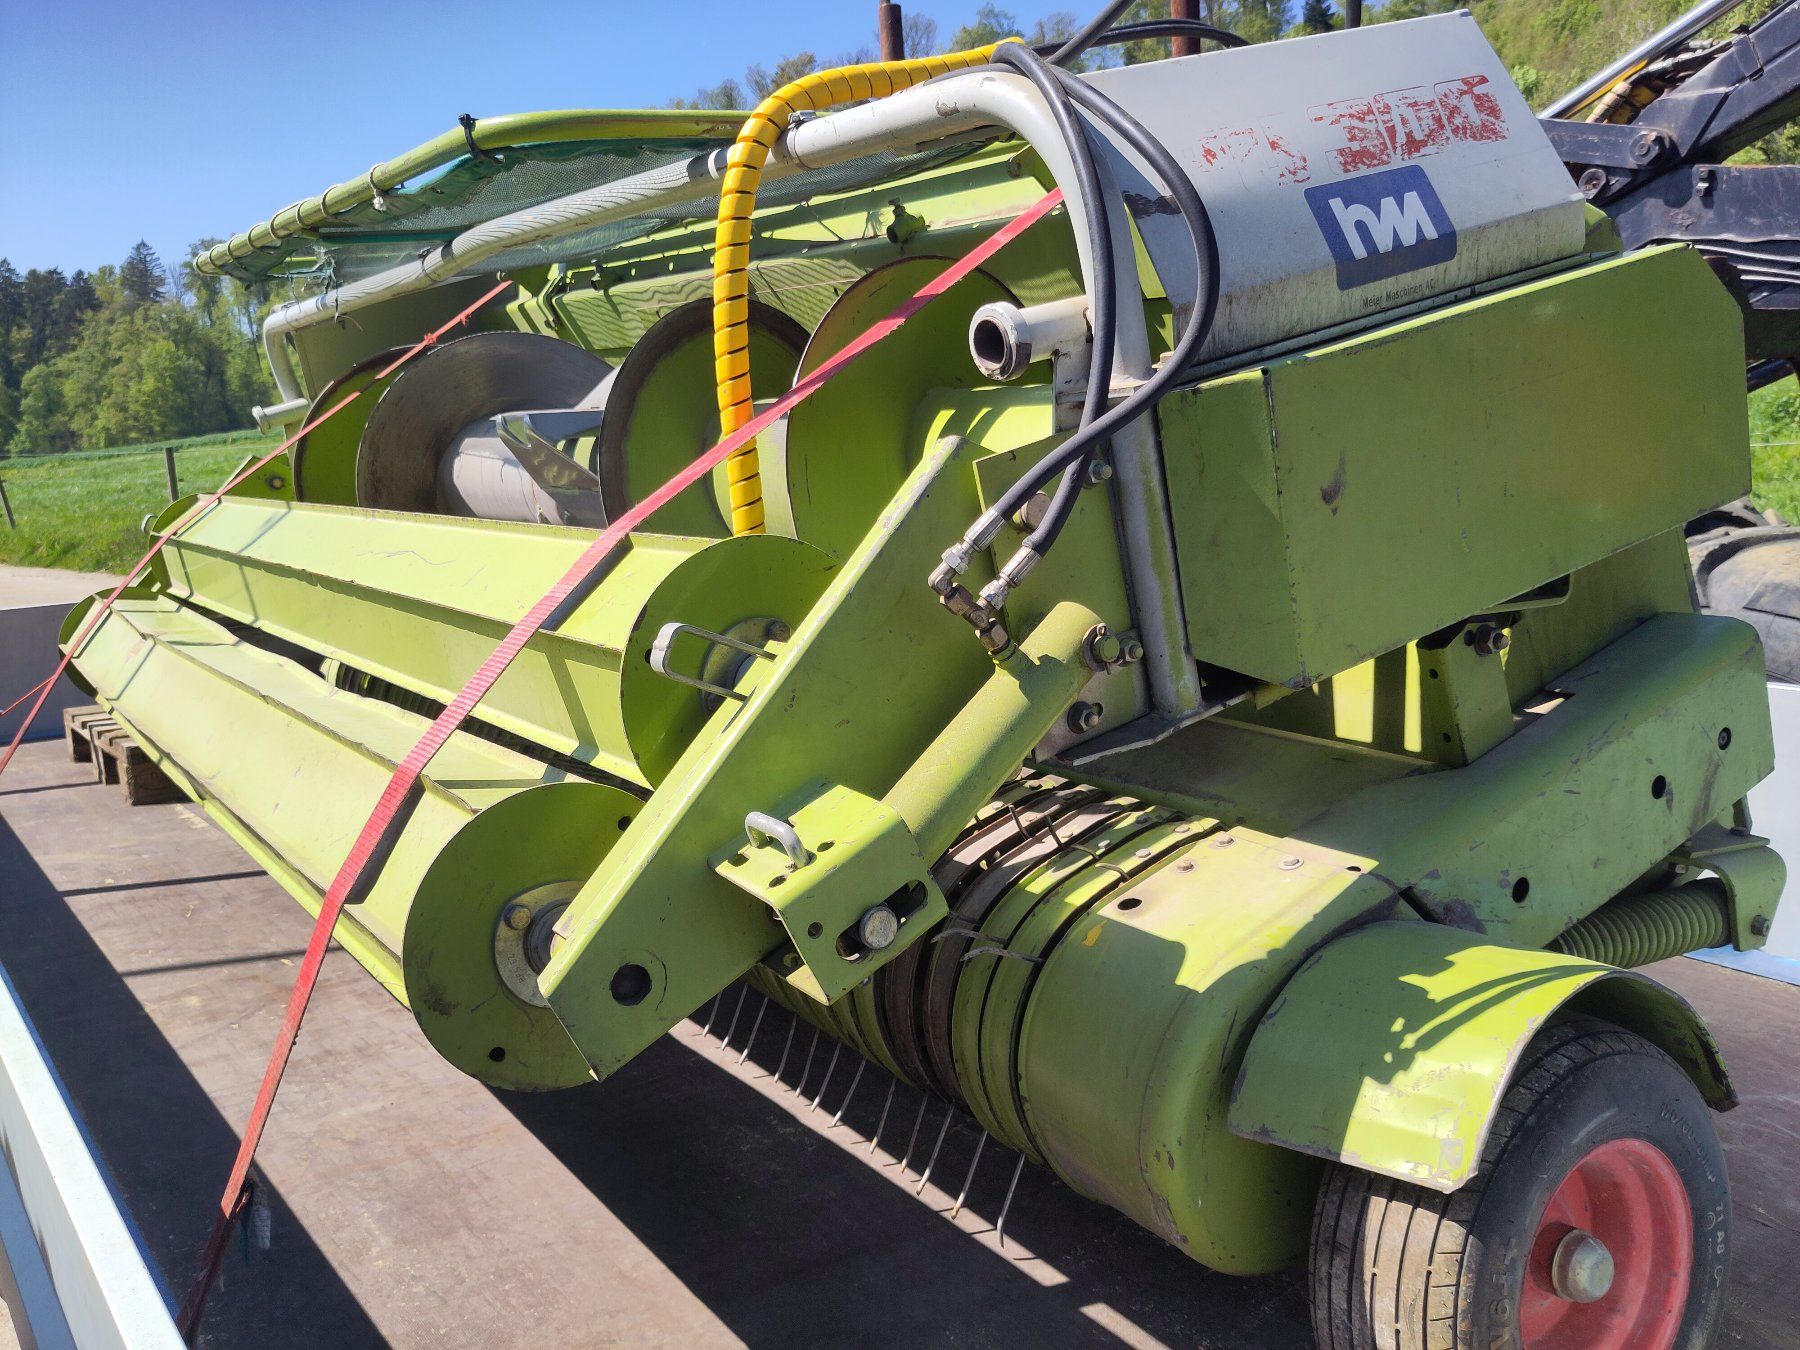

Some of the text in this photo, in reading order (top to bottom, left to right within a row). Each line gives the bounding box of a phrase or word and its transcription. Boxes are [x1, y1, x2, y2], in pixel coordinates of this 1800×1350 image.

[1306, 75, 1509, 175] 300
[1362, 295, 1383, 309] Meier
[1385, 283, 1423, 302] Maschinen
